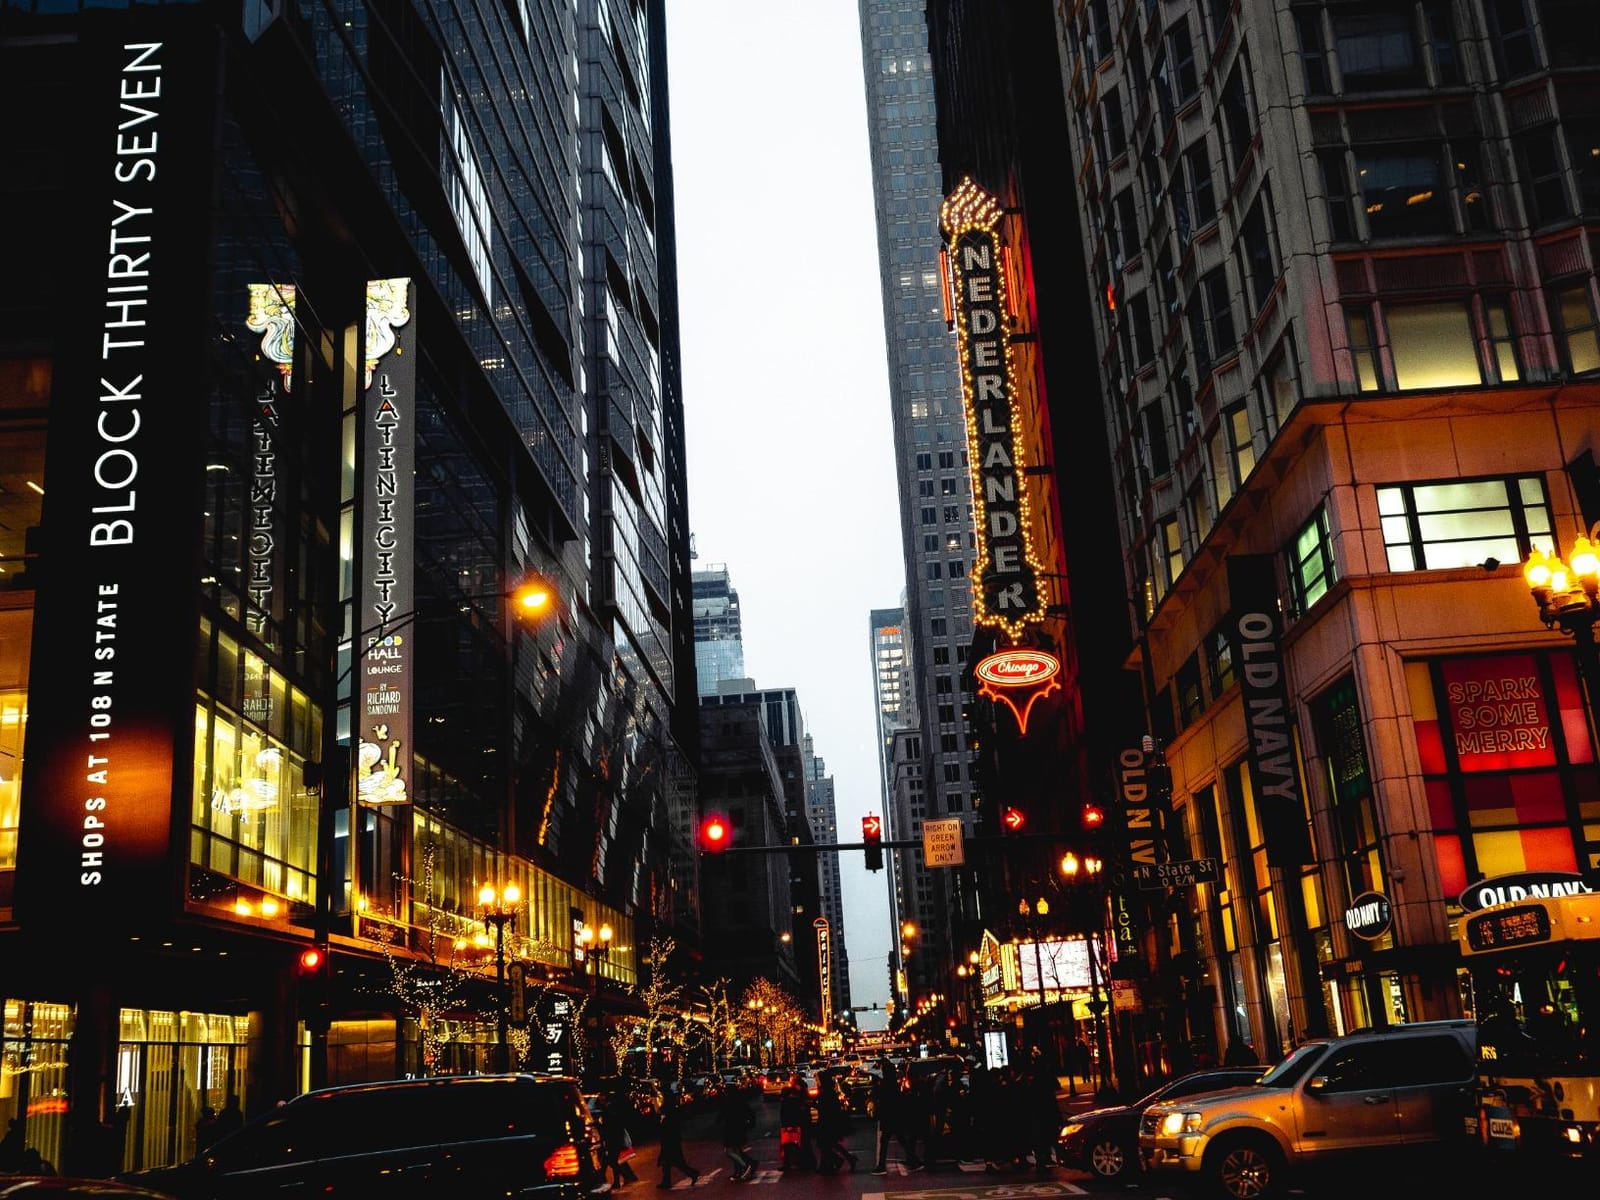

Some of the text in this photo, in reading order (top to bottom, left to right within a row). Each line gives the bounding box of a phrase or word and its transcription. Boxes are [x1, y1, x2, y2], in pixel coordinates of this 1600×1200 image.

[90, 42, 163, 546] BLOCK THIRTY SEVEN
[963, 245, 1026, 610] NEDERLANDER
[375, 374, 399, 627] LATINICITY
[367, 648, 402, 660] HALL
[367, 664, 402, 675] LOUNGE
[997, 660, 1040, 677] Chicago
[367, 691, 400, 705] RICHARD
[1448, 677, 1539, 704] SPARK
[367, 704, 400, 715] SANDOVAL
[1239, 612, 1298, 801] OLD NAVY
[1458, 702, 1539, 729] SOME
[80, 583, 119, 886] SHOPS AT 108 N STATE
[1456, 727, 1548, 755] MERRY
[1120, 747, 1149, 802] OLD
[925, 823, 958, 832] RIGHT ON
[931, 834, 955, 843] GREEN
[932, 844, 955, 852] ARROW
[935, 852, 954, 862] ONLY
[1142, 859, 1212, 879] N State St
[1118, 895, 1132, 941] tea
